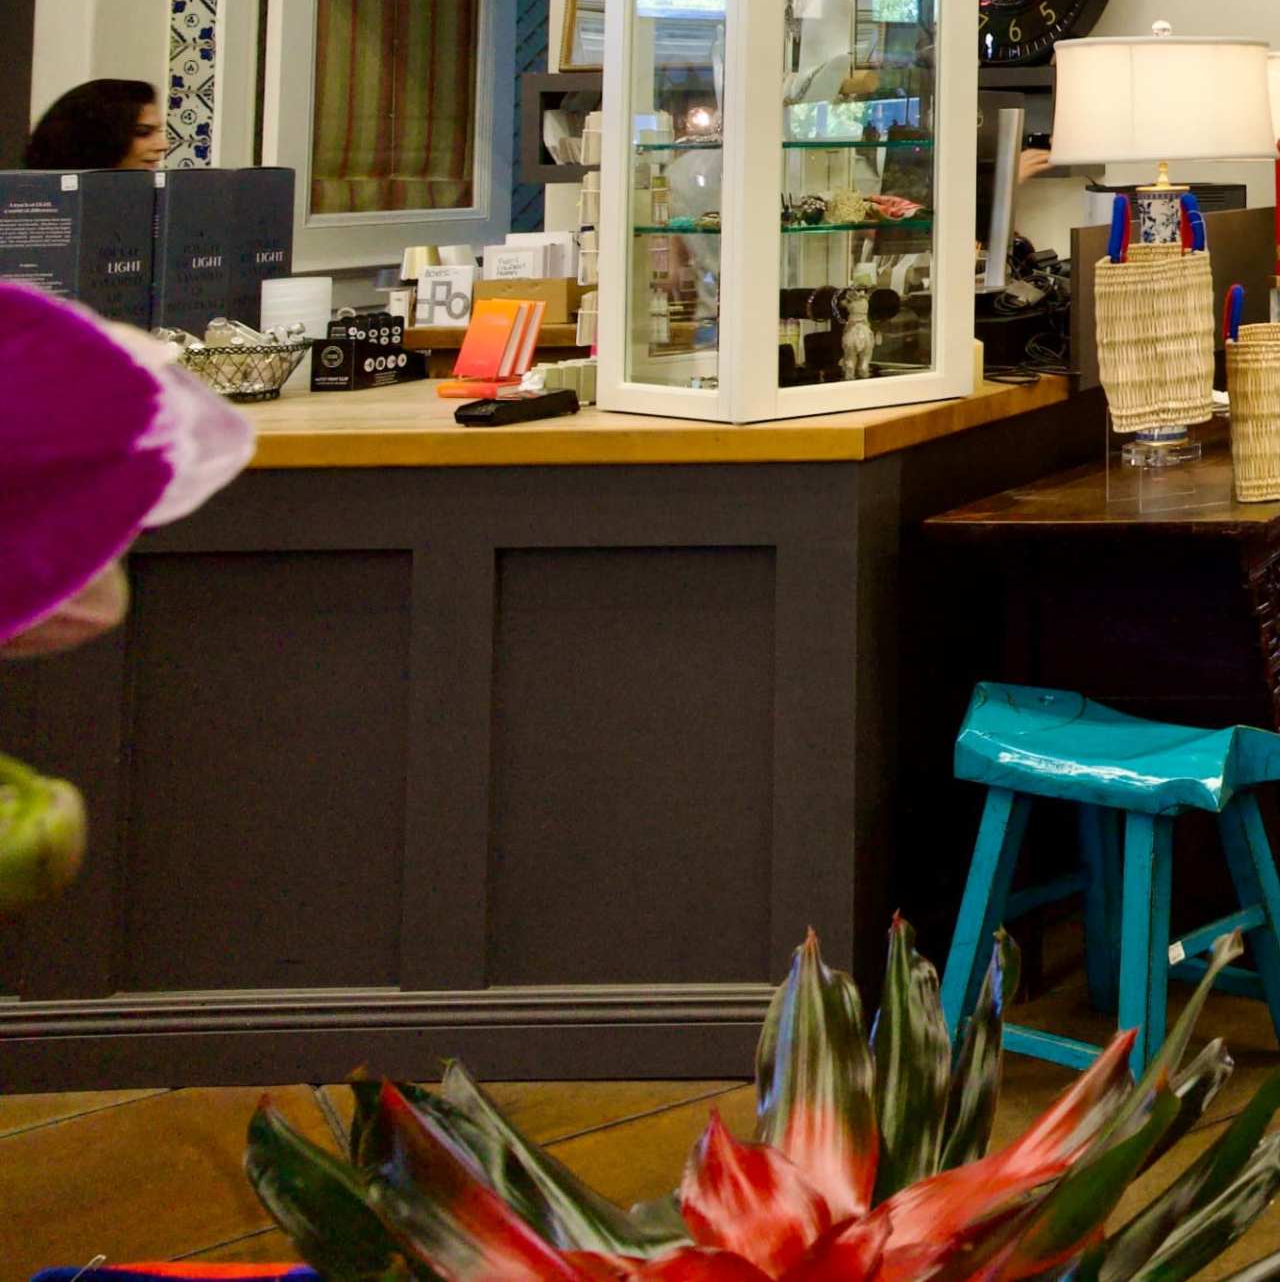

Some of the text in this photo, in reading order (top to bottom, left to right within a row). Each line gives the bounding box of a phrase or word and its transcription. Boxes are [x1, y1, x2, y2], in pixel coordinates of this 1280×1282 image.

[1039, 1, 1057, 26] 5
[1008, 18, 1022, 43] 6
[192, 255, 223, 269] LIGHT
[256, 250, 285, 263] LIGHT
[107, 260, 142, 274] LIGHT
